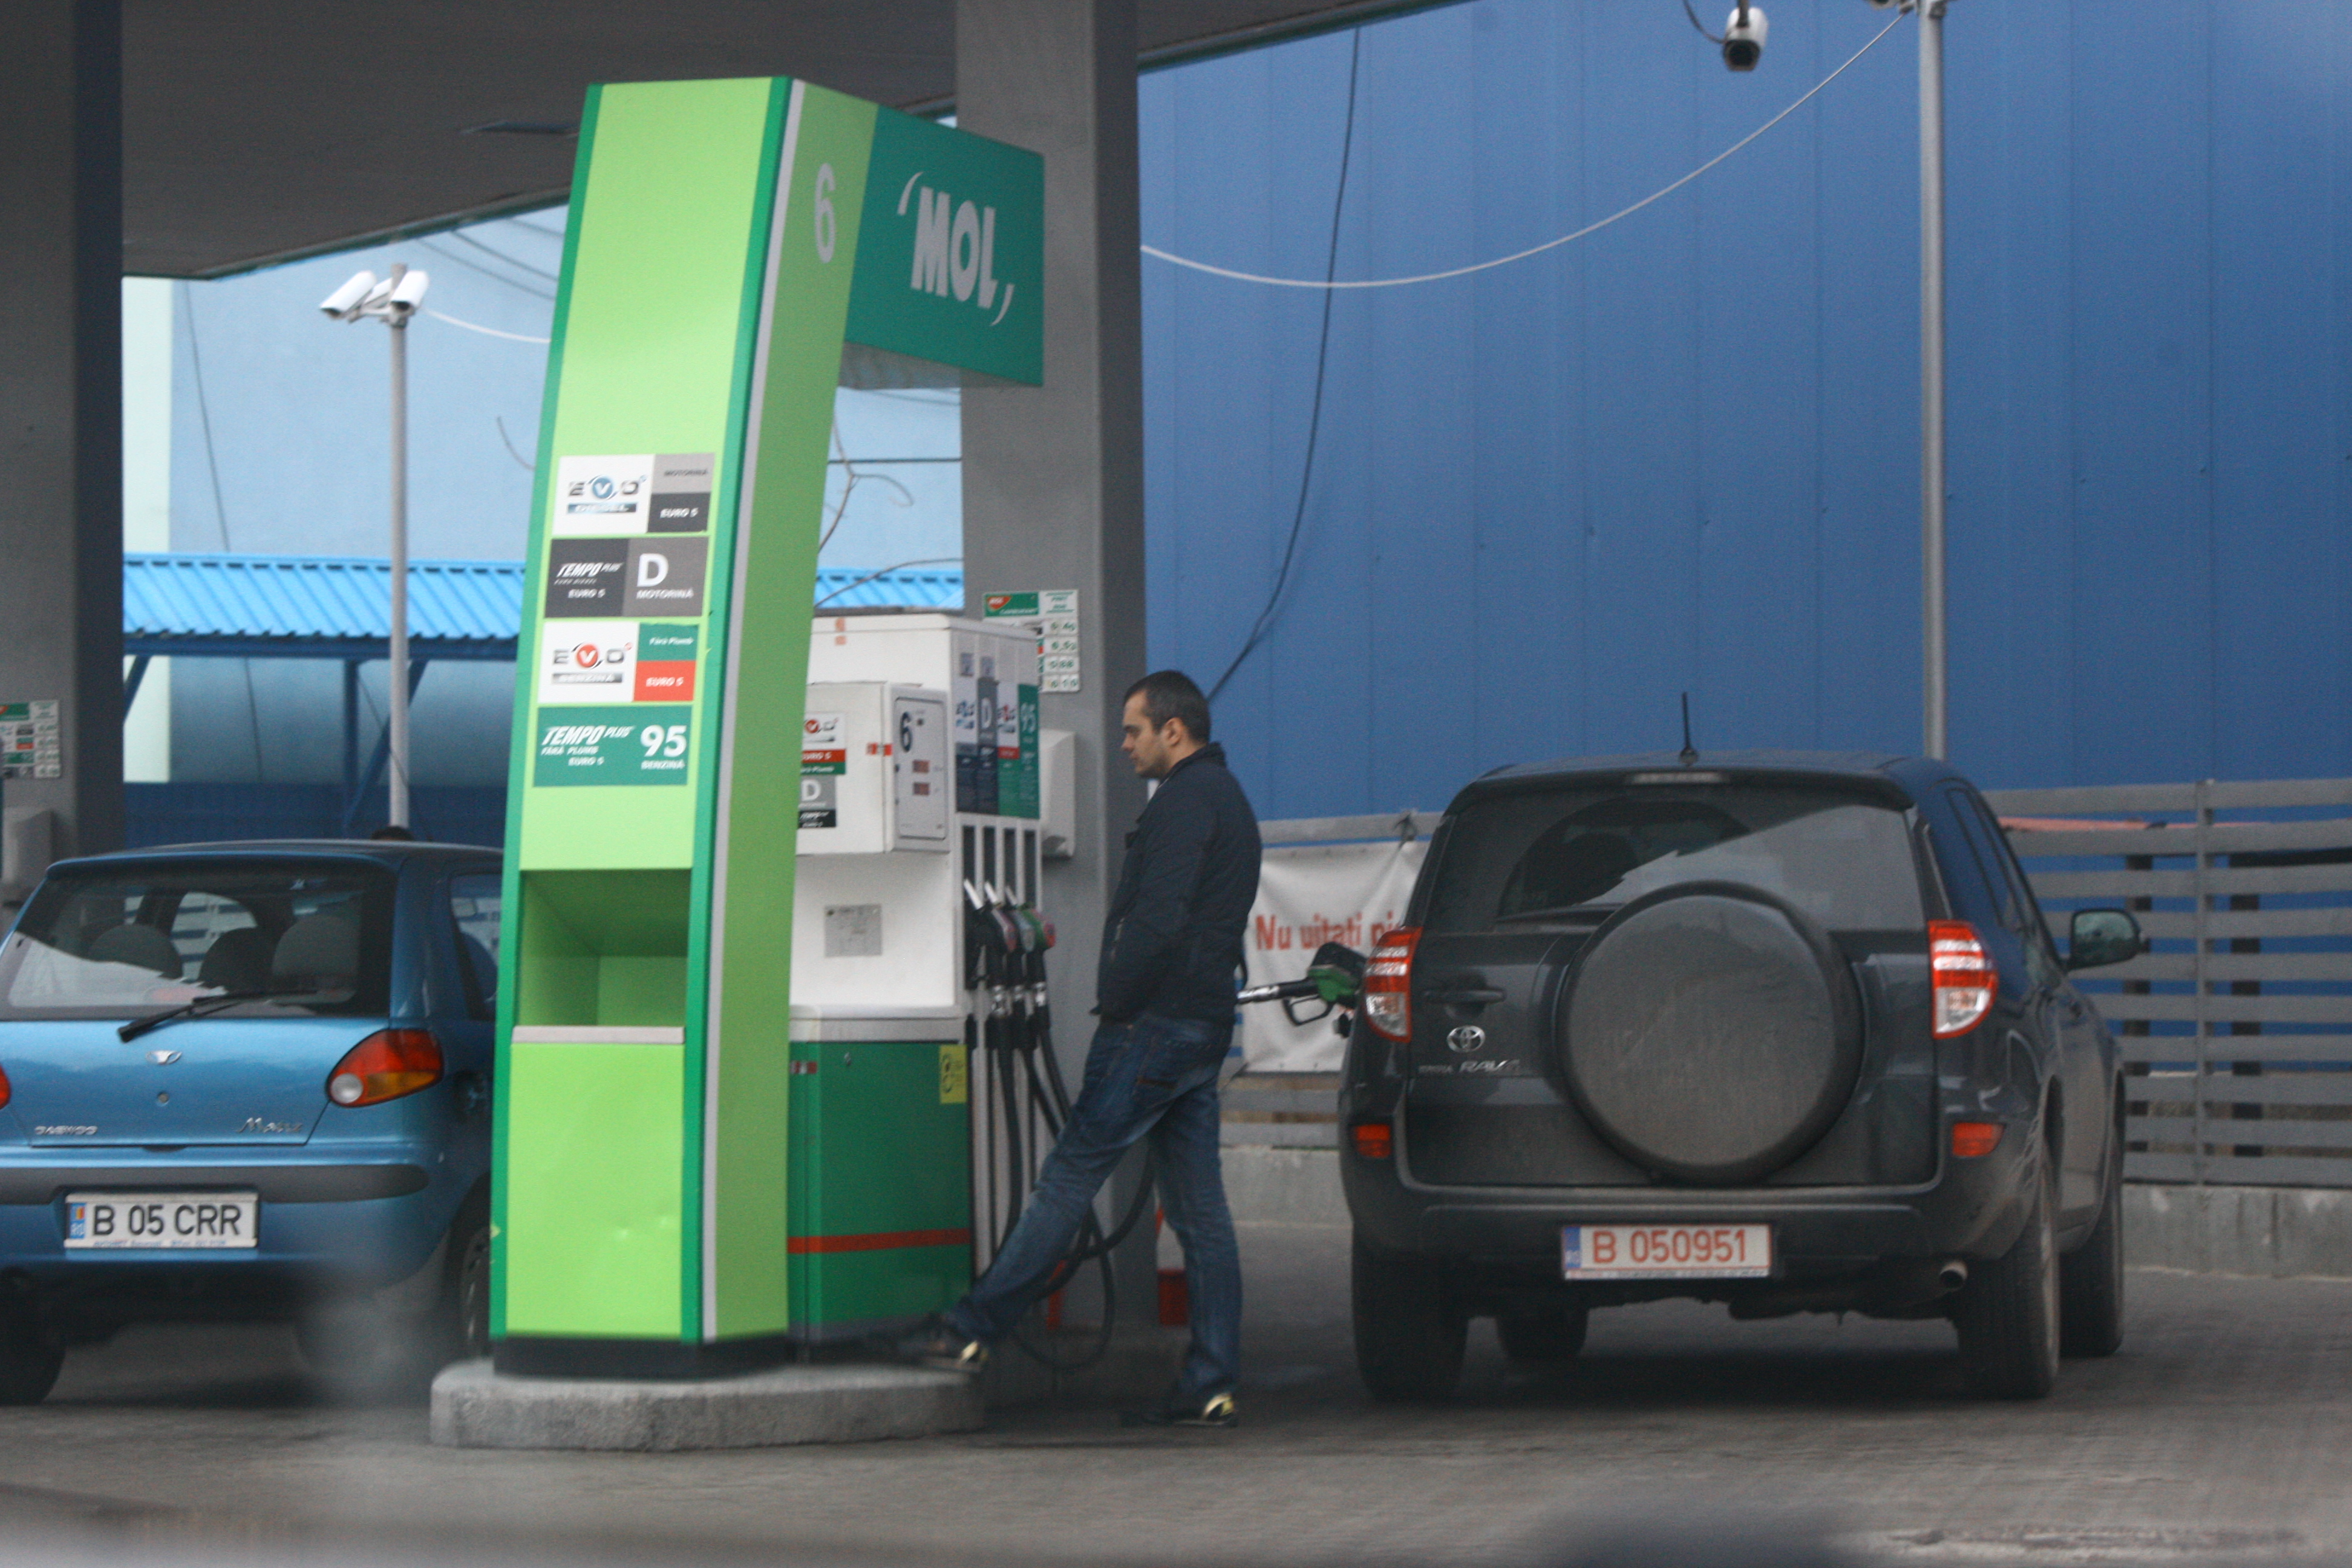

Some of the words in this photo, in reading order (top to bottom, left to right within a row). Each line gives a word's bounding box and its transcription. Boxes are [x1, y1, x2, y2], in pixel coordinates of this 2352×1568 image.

[814, 162, 836, 264] 6
[910, 186, 999, 310] MOL
[568, 475, 639, 500] EVO
[556, 562, 604, 578] TEMPO
[636, 553, 669, 587] D
[552, 642, 626, 669] EVO
[541, 725, 607, 746] TEMPO
[639, 724, 688, 758] 95
[900, 711, 913, 753] 6
[802, 779, 822, 802] D
[1255, 914, 1292, 950] Nu
[93, 1204, 116, 1236] B
[128, 1204, 165, 1236] 05
[173, 1204, 242, 1236] CRR
[1592, 1230, 1617, 1264] B
[1629, 1229, 1746, 1263] 050951
